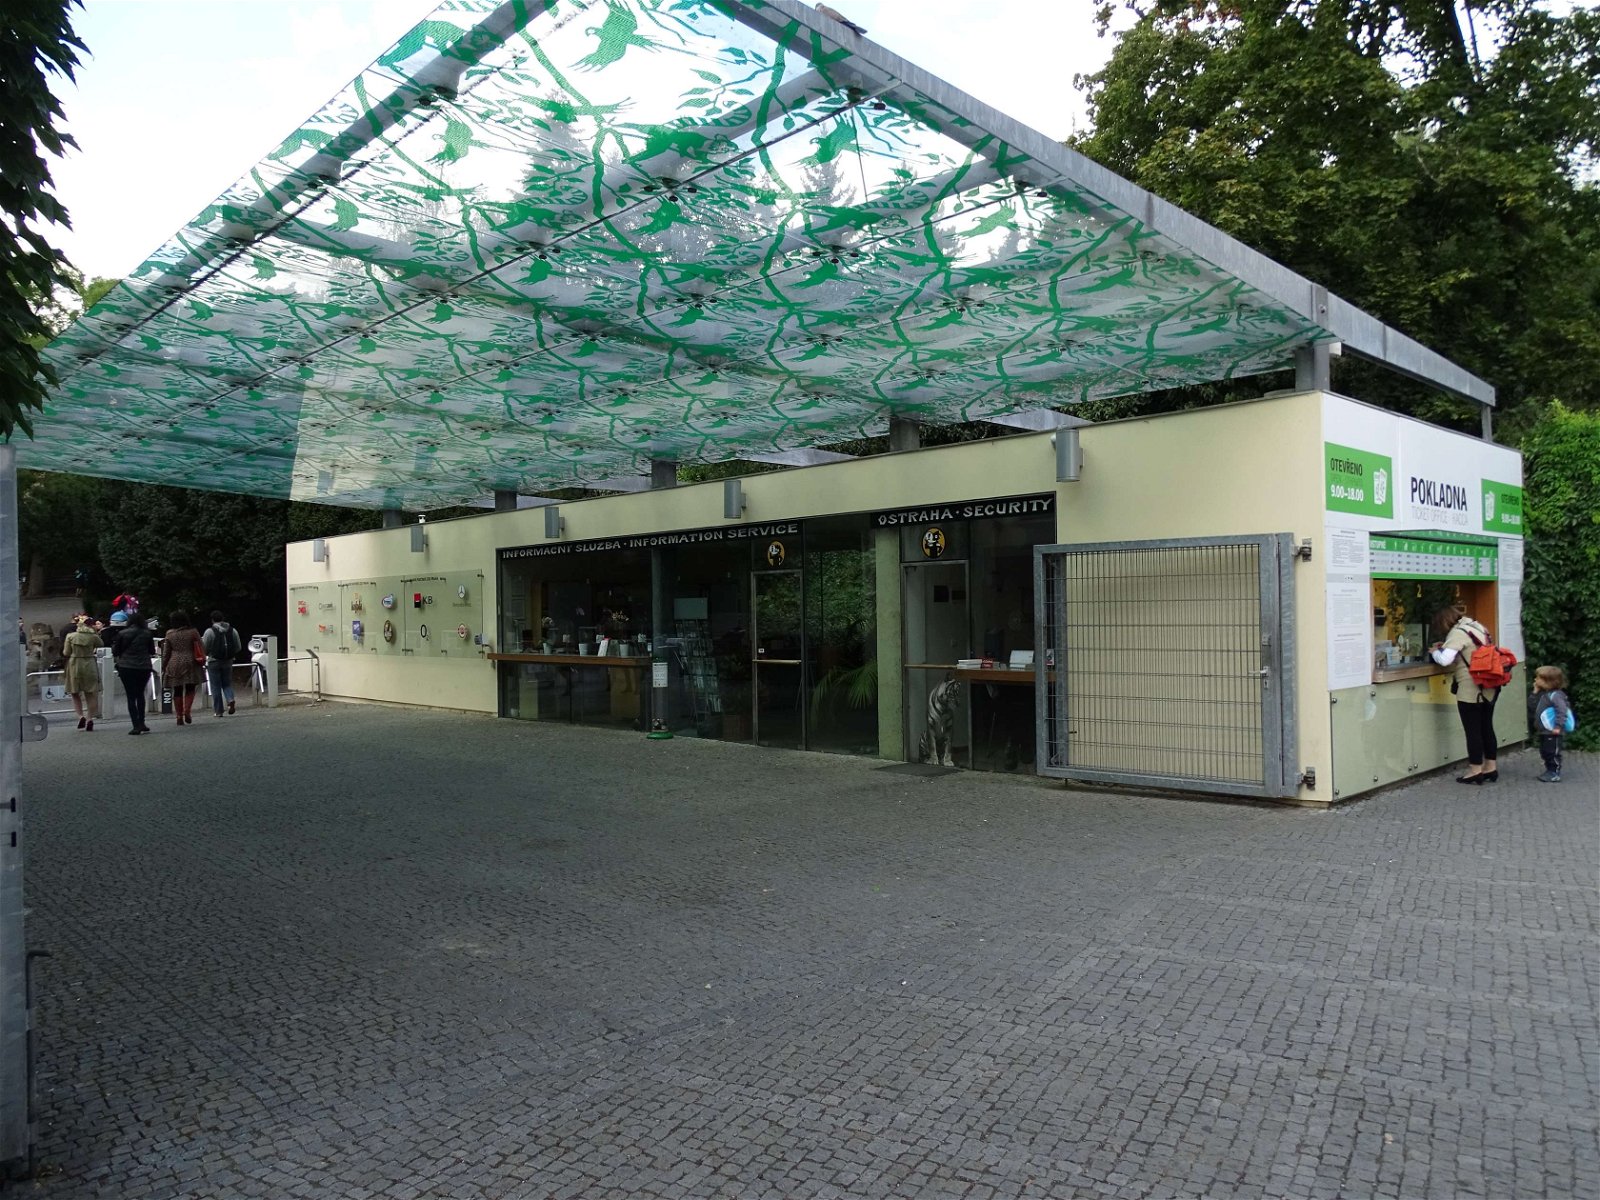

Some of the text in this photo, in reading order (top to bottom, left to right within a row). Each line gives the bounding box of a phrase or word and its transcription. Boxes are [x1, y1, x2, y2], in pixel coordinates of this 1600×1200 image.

[1330, 457, 1363, 476] OTEVŘENO
[1410, 476, 1468, 511] POKLADNA
[878, 498, 1053, 526] OSTRAHA SECURITY
[629, 530, 723, 547] INFORMATION
[727, 523, 799, 539] SERVICE
[422, 596, 433, 605] KB
[1416, 584, 1422, 598] 2
